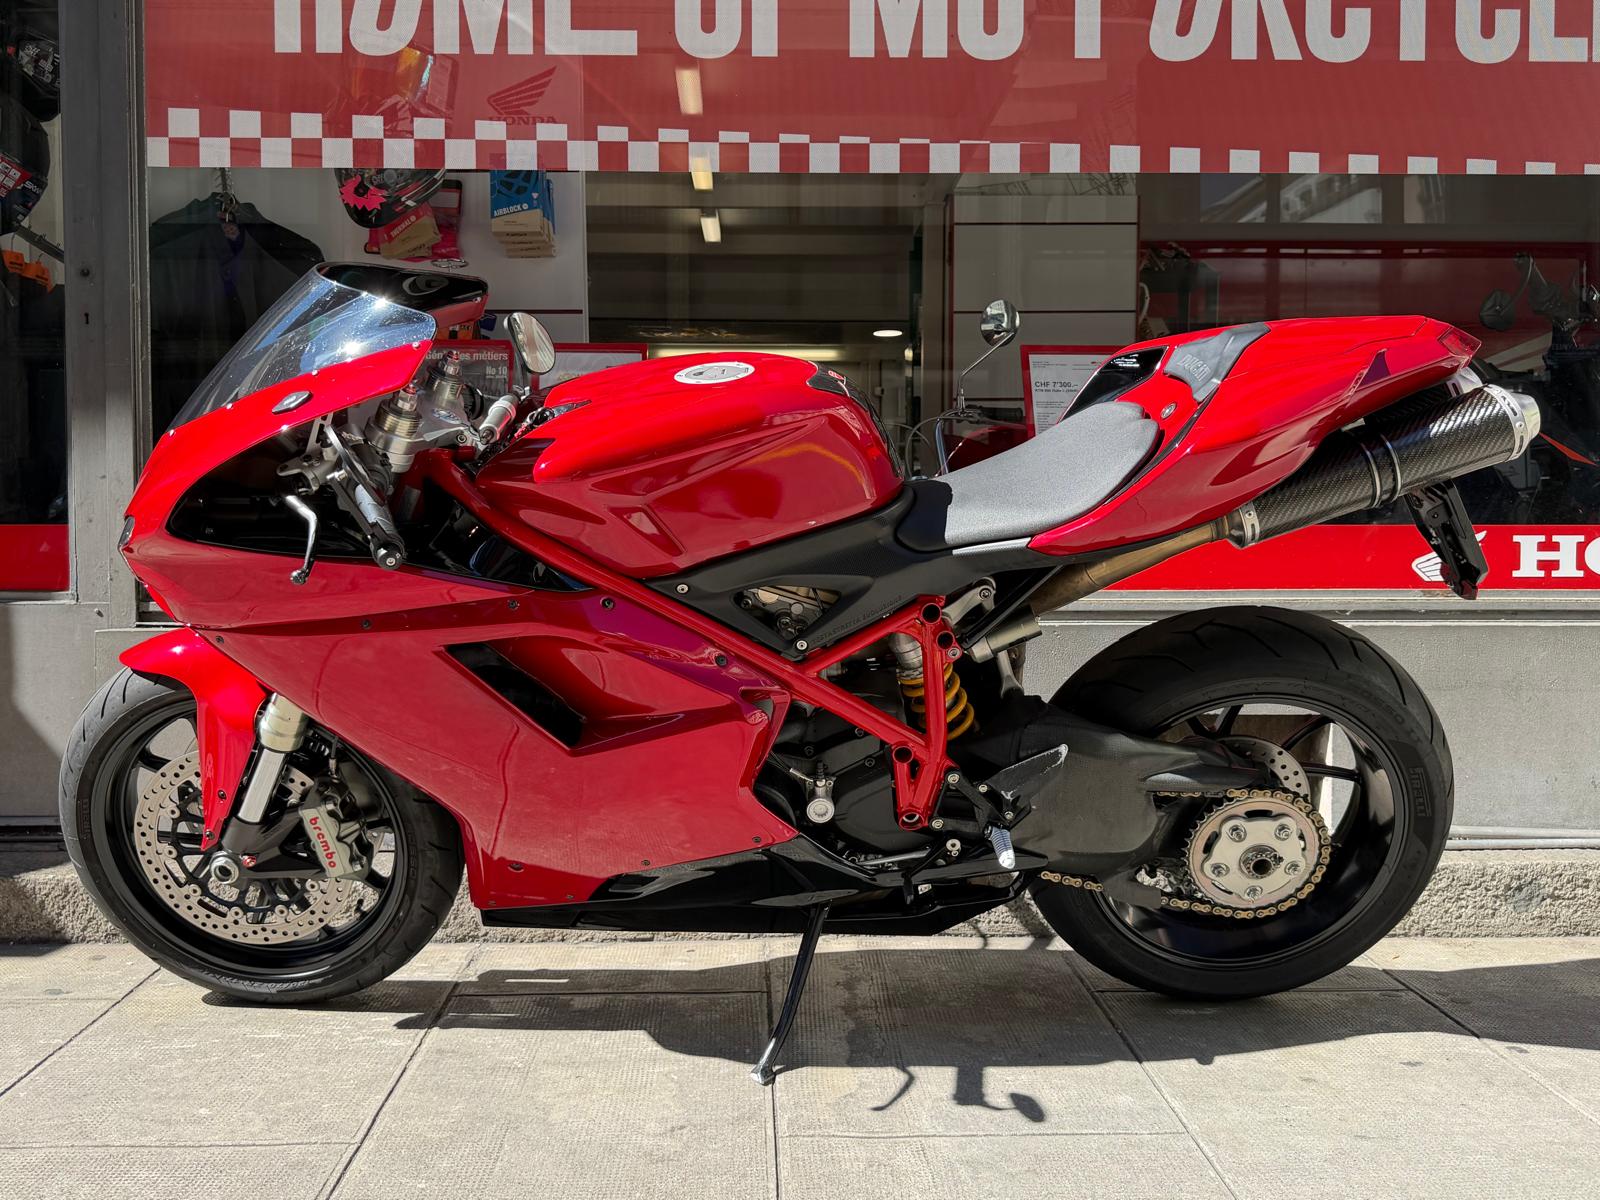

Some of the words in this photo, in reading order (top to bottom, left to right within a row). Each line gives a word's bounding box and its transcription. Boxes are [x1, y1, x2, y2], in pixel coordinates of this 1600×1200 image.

[494, 204, 522, 218] AIRBLOCK
[473, 351, 508, 360] métiers
[1177, 354, 1212, 382] DUCATI
[1409, 767, 1432, 818] PIRELLI
[309, 816, 337, 868] brembo
